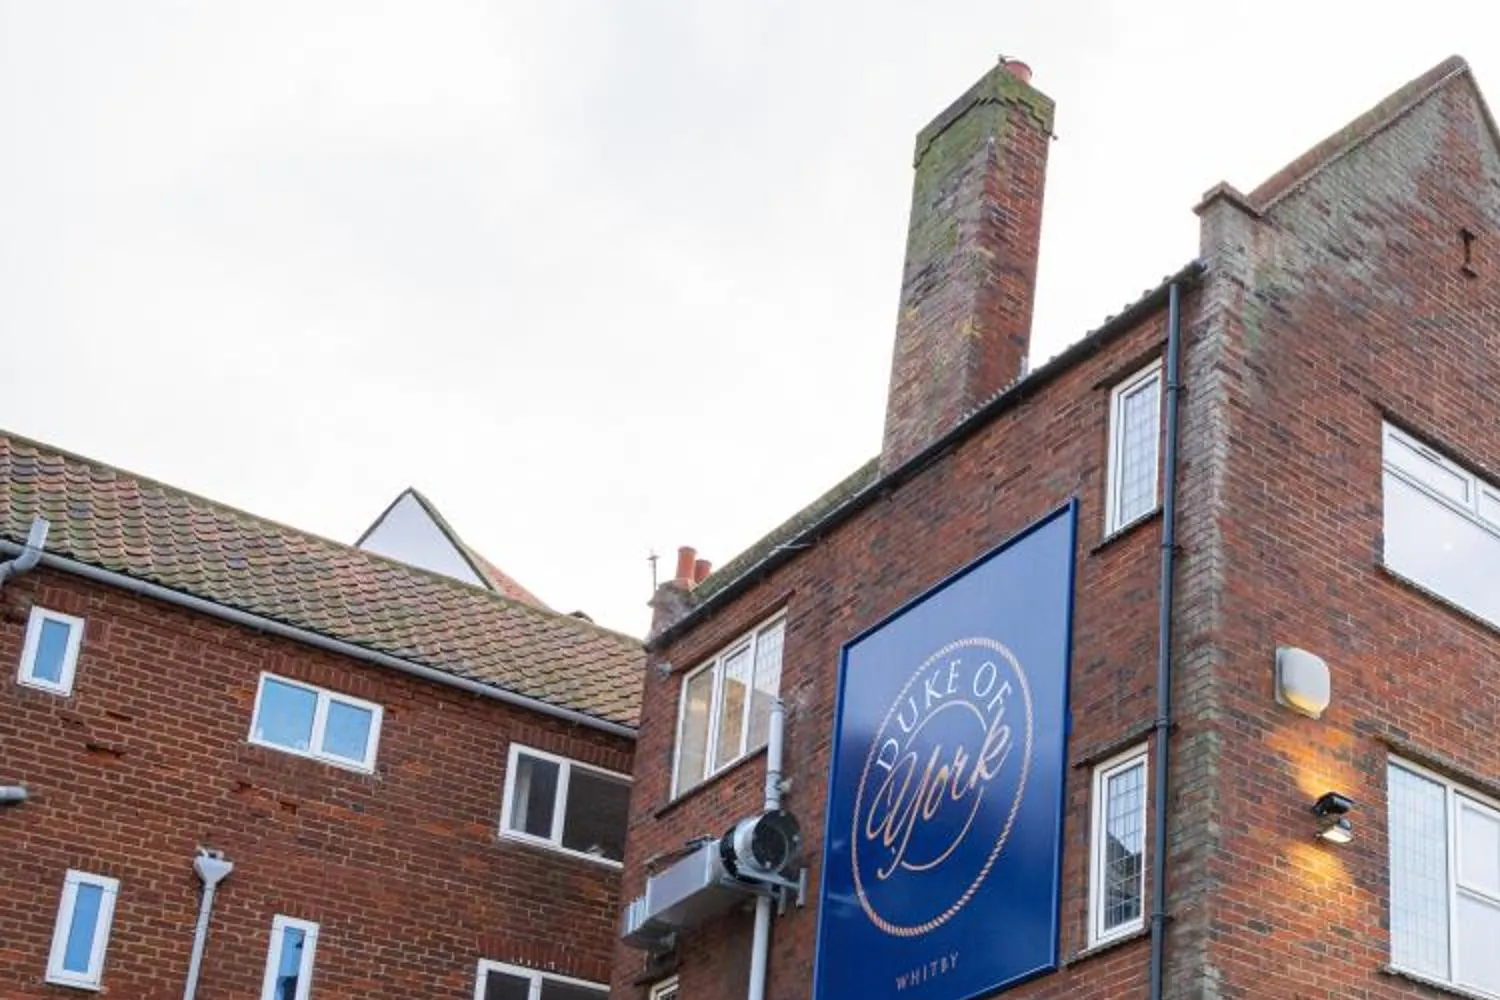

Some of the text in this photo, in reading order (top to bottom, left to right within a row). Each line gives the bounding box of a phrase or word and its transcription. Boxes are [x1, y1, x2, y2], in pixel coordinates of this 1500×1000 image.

[875, 658, 1013, 772] DUKE OF
[866, 709, 1013, 880] York
[896, 951, 960, 991] WHITBY
